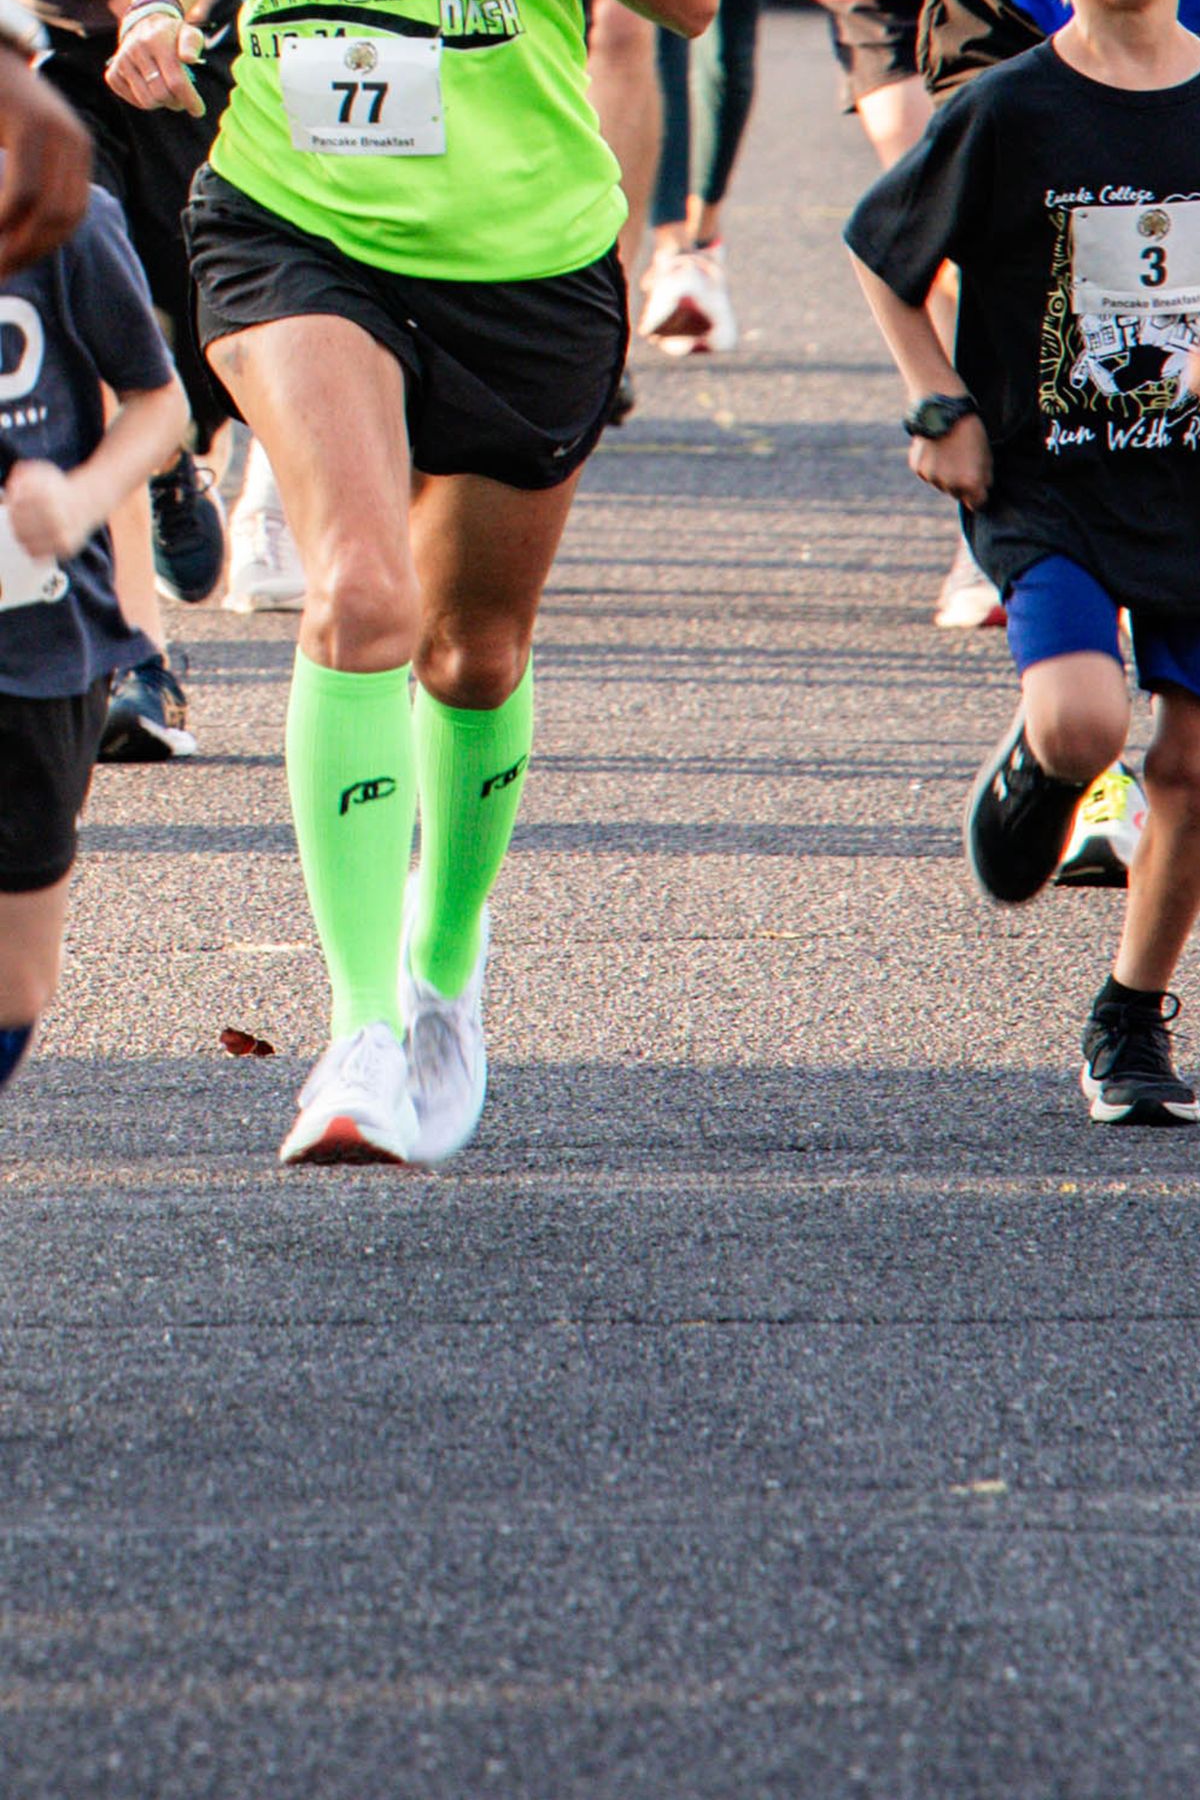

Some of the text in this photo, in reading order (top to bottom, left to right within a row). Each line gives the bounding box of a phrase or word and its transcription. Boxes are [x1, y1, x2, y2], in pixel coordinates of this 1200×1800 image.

[332, 81, 388, 123] 77
[312, 136, 415, 147] Pancake Breakfast
[1100, 185, 1155, 204] College
[1140, 246, 1167, 287] 3
[1102, 294, 1200, 308] Pancake Breakfast
[1045, 418, 1096, 455] Run
[1107, 414, 1173, 451] With
